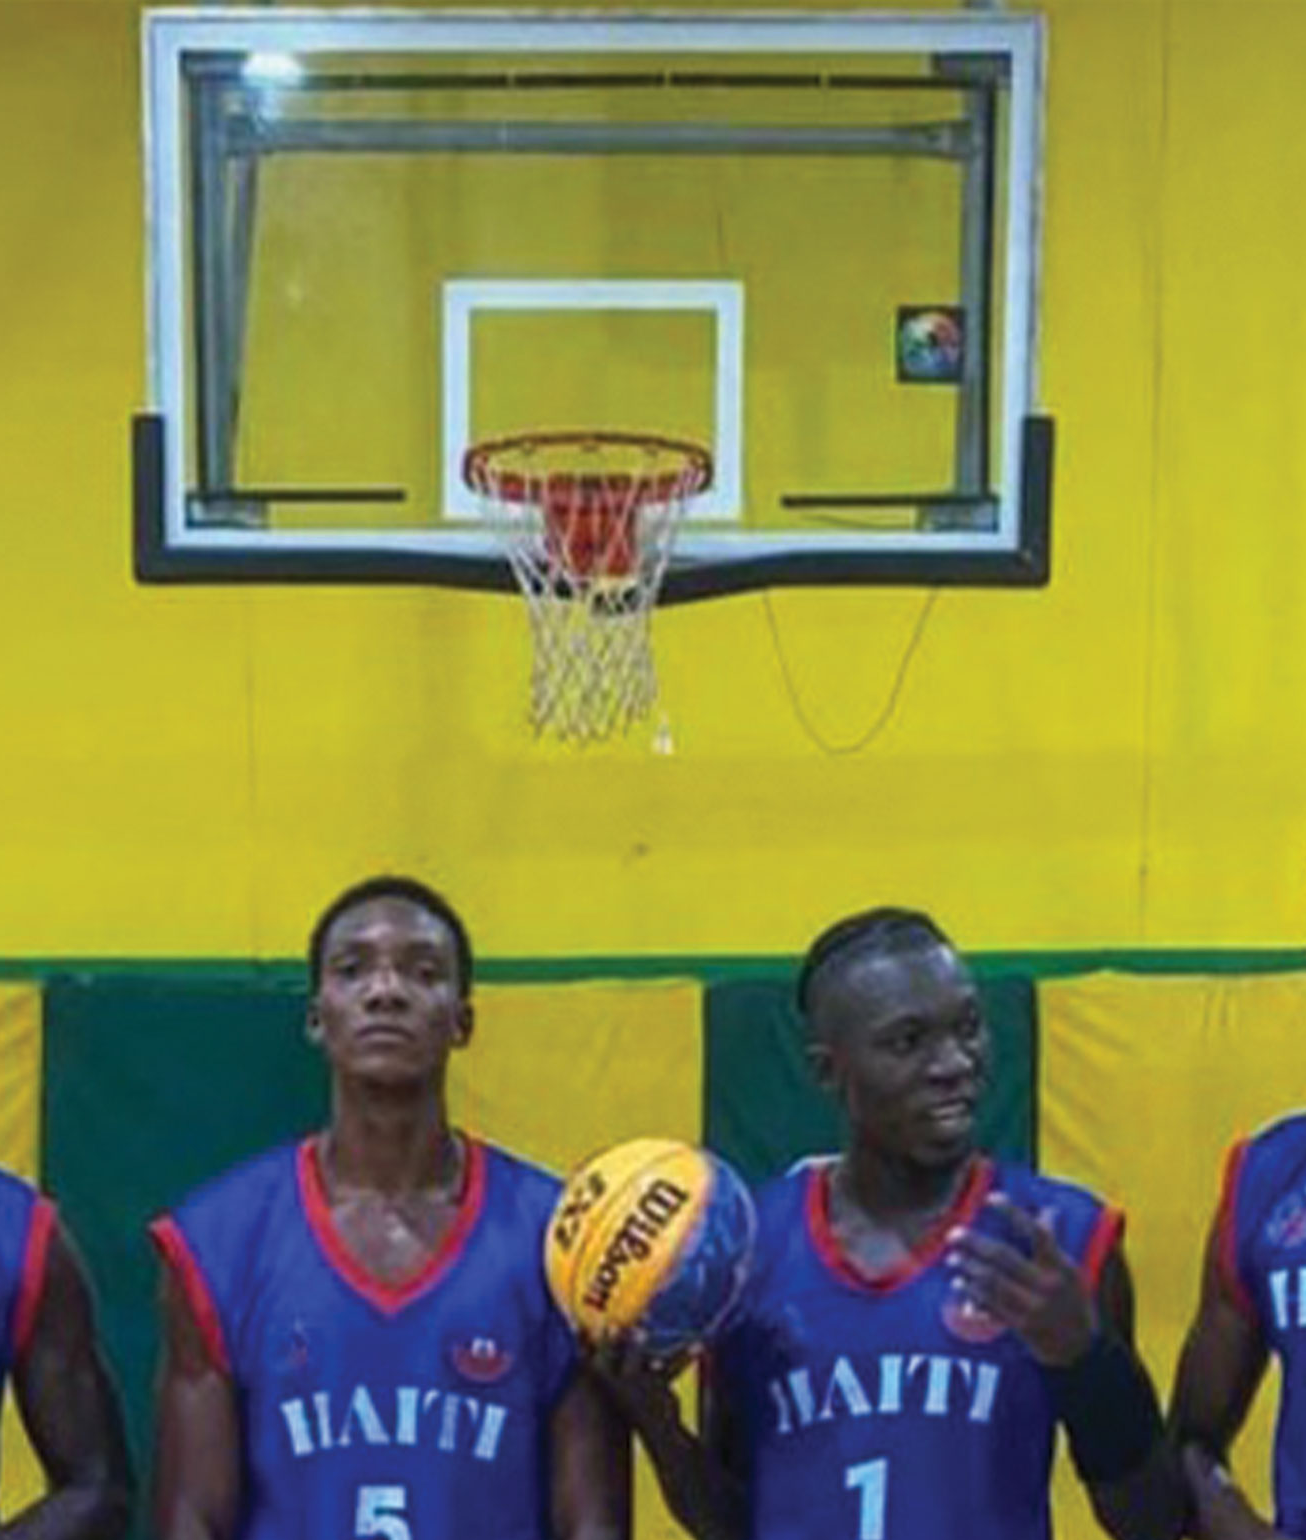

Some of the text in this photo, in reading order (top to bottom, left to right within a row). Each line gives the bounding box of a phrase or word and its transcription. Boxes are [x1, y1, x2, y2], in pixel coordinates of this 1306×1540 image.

[582, 1178, 690, 1312] Wilson
[282, 1386, 506, 1459] HAITI
[772, 1354, 1000, 1434] HAITI
